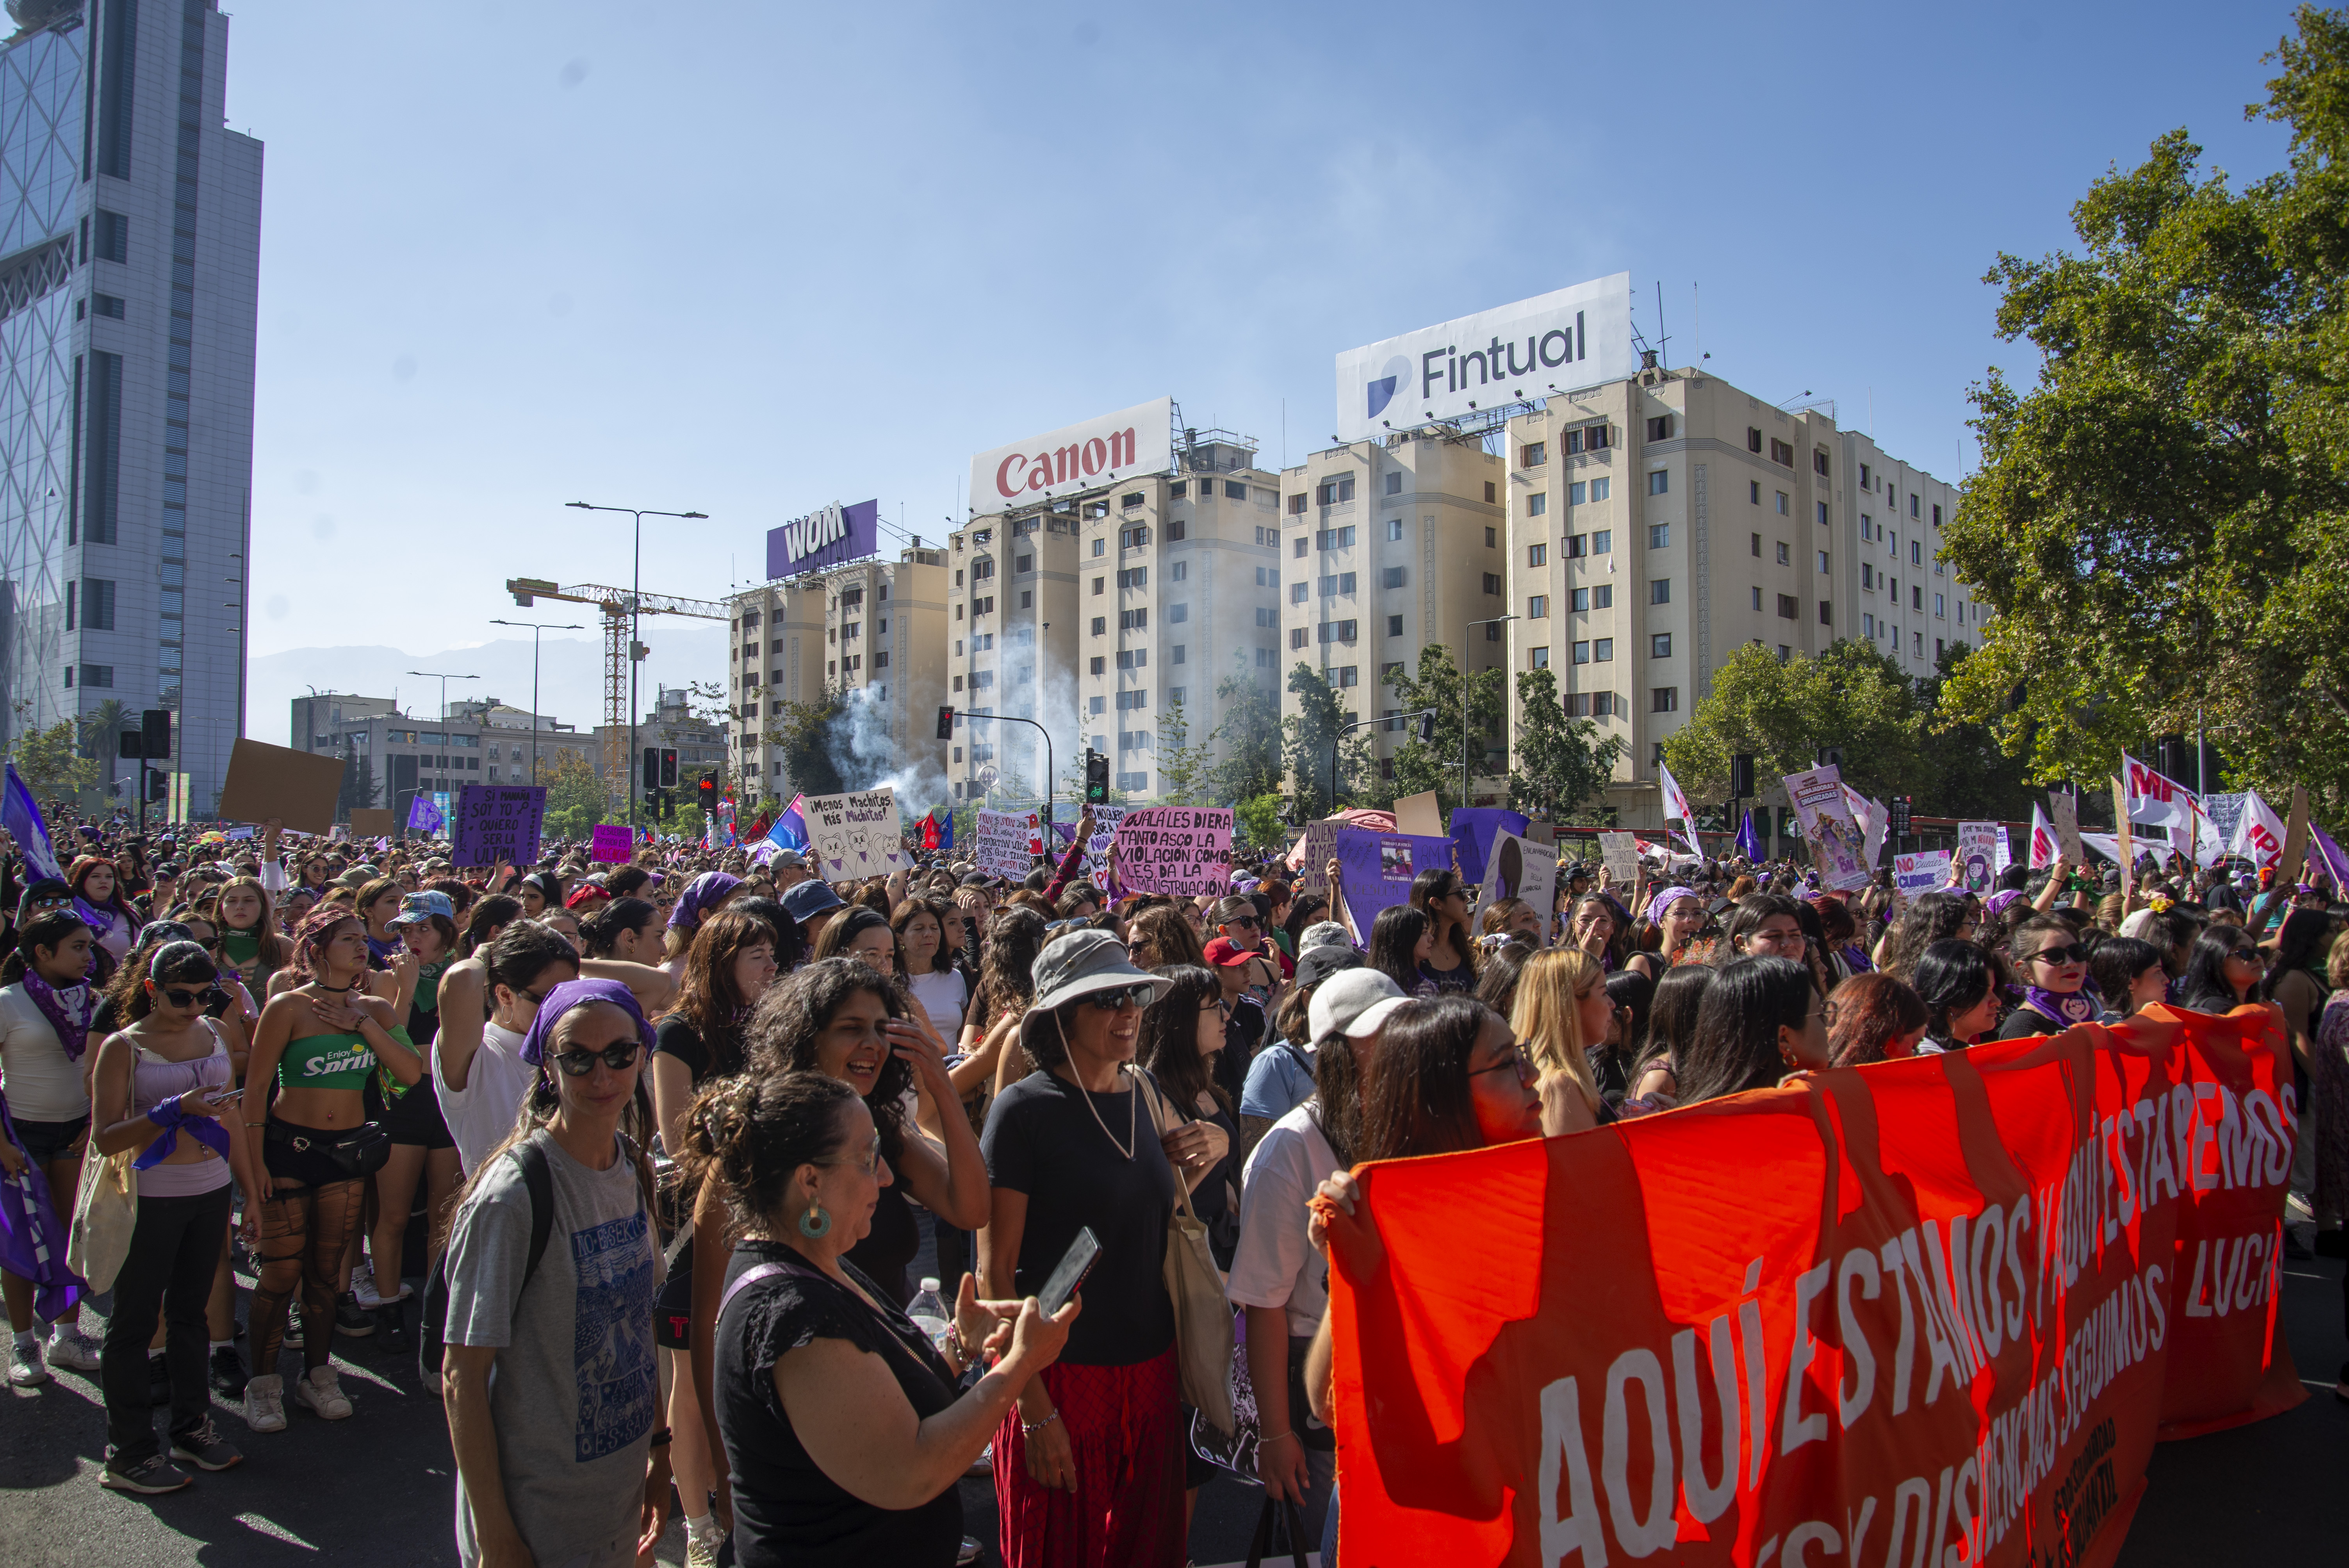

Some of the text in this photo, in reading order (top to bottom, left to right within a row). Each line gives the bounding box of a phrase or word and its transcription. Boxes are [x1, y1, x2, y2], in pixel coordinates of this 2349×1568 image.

[1422, 310, 1585, 399] Fintual
[996, 427, 1135, 498] Canon
[784, 499, 845, 563] WOM
[1798, 783, 1835, 796] TRABAJADORAS
[810, 793, 893, 813] ¡Menos Machitos,
[1801, 791, 1837, 806] ORGANIZADAS
[471, 803, 512, 818] SOY YO
[823, 807, 888, 827] Más Michitos!
[1096, 808, 1106, 820] NO
[978, 813, 993, 824] SON
[1000, 817, 1016, 827] SON
[1125, 808, 1167, 827] OJALÁ
[1167, 811, 1190, 829] LES
[1194, 812, 1230, 830] DIERA
[978, 824, 991, 835] SON
[1016, 830, 1027, 841] NO
[1094, 821, 1109, 836] QUE
[1108, 821, 1116, 834] A
[1962, 825, 1974, 834] por
[483, 833, 515, 845] SER LA
[978, 836, 1023, 850] IMPORTAN LOS
[1118, 830, 1215, 848] TANTO ASCO LA
[1959, 834, 1995, 848] POR MI ABUELA
[977, 846, 992, 857] AÑOS
[1009, 851, 1030, 862] TIENES
[1117, 845, 1230, 864] VIOLACIÓN COMO
[1306, 844, 1316, 859] NO
[1523, 846, 1556, 860] ENCANTADORA
[1964, 846, 1975, 861] por
[998, 859, 1017, 870] ABUSO
[1125, 864, 1201, 879] LES DA LA
[1305, 859, 1315, 872] NO
[1837, 855, 1855, 874] 8M
[1895, 857, 1945, 875] NO puedes
[993, 867, 1001, 876] SE
[1004, 871, 1026, 880] DETIEN
[1530, 873, 1542, 882] BELLA
[1611, 865, 1618, 880] DE
[1136, 877, 1230, 897] MENSTRUACIÓN.
[327, 1049, 351, 1060] Enjoy
[303, 1048, 377, 1077] Sprite
[575, 1234, 594, 1258] NO
[2060, 1263, 2166, 1448] SEGUIMOS
[615, 1371, 641, 1393] AGUA
[1539, 1254, 1766, 1568] AQUÍ
[1782, 1193, 2030, 1457] ESTAMOS
[611, 1393, 626, 1405] ES
[595, 1427, 618, 1454] ES
